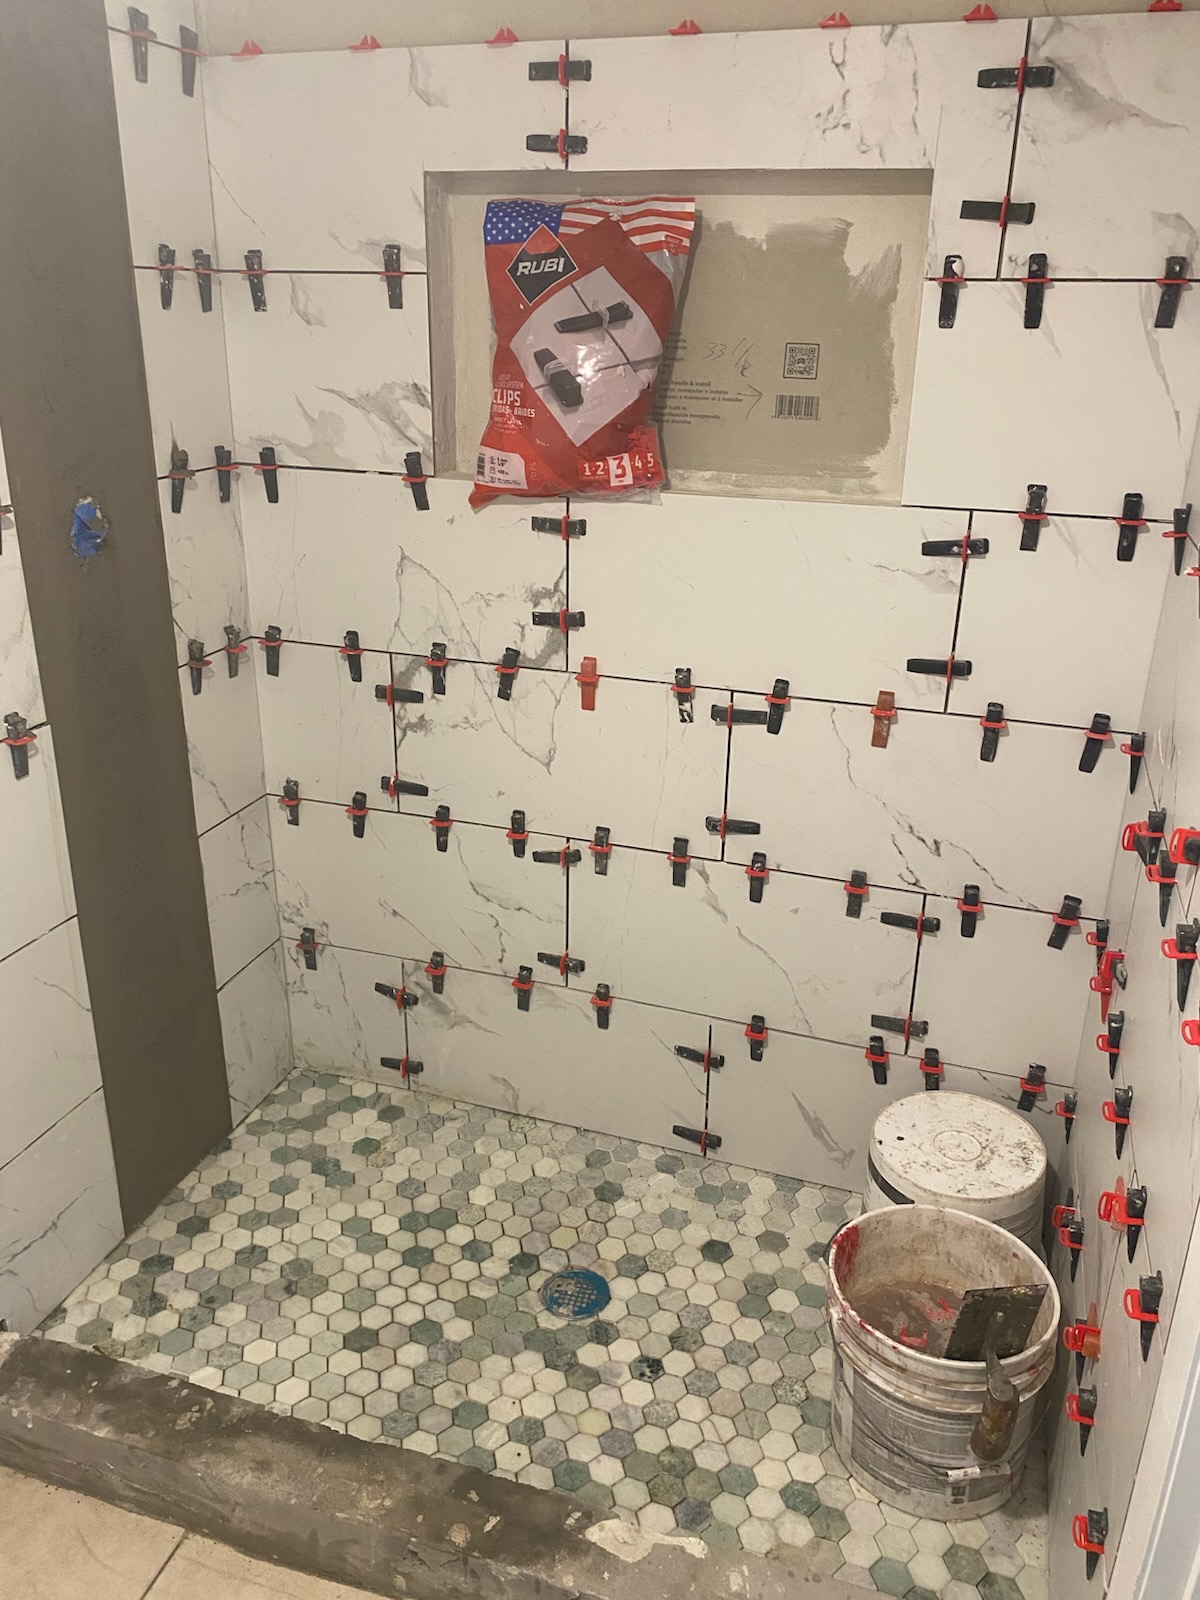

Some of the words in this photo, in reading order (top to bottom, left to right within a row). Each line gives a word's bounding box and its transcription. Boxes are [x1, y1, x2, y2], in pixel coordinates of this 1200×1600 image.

[516, 257, 565, 276] RUBI
[514, 407, 536, 418] BRIDES
[583, 462, 592, 476] 1
[595, 461, 605, 475] 2
[611, 455, 627, 479] 3
[634, 454, 643, 469] 4
[646, 452, 654, 468] 5
